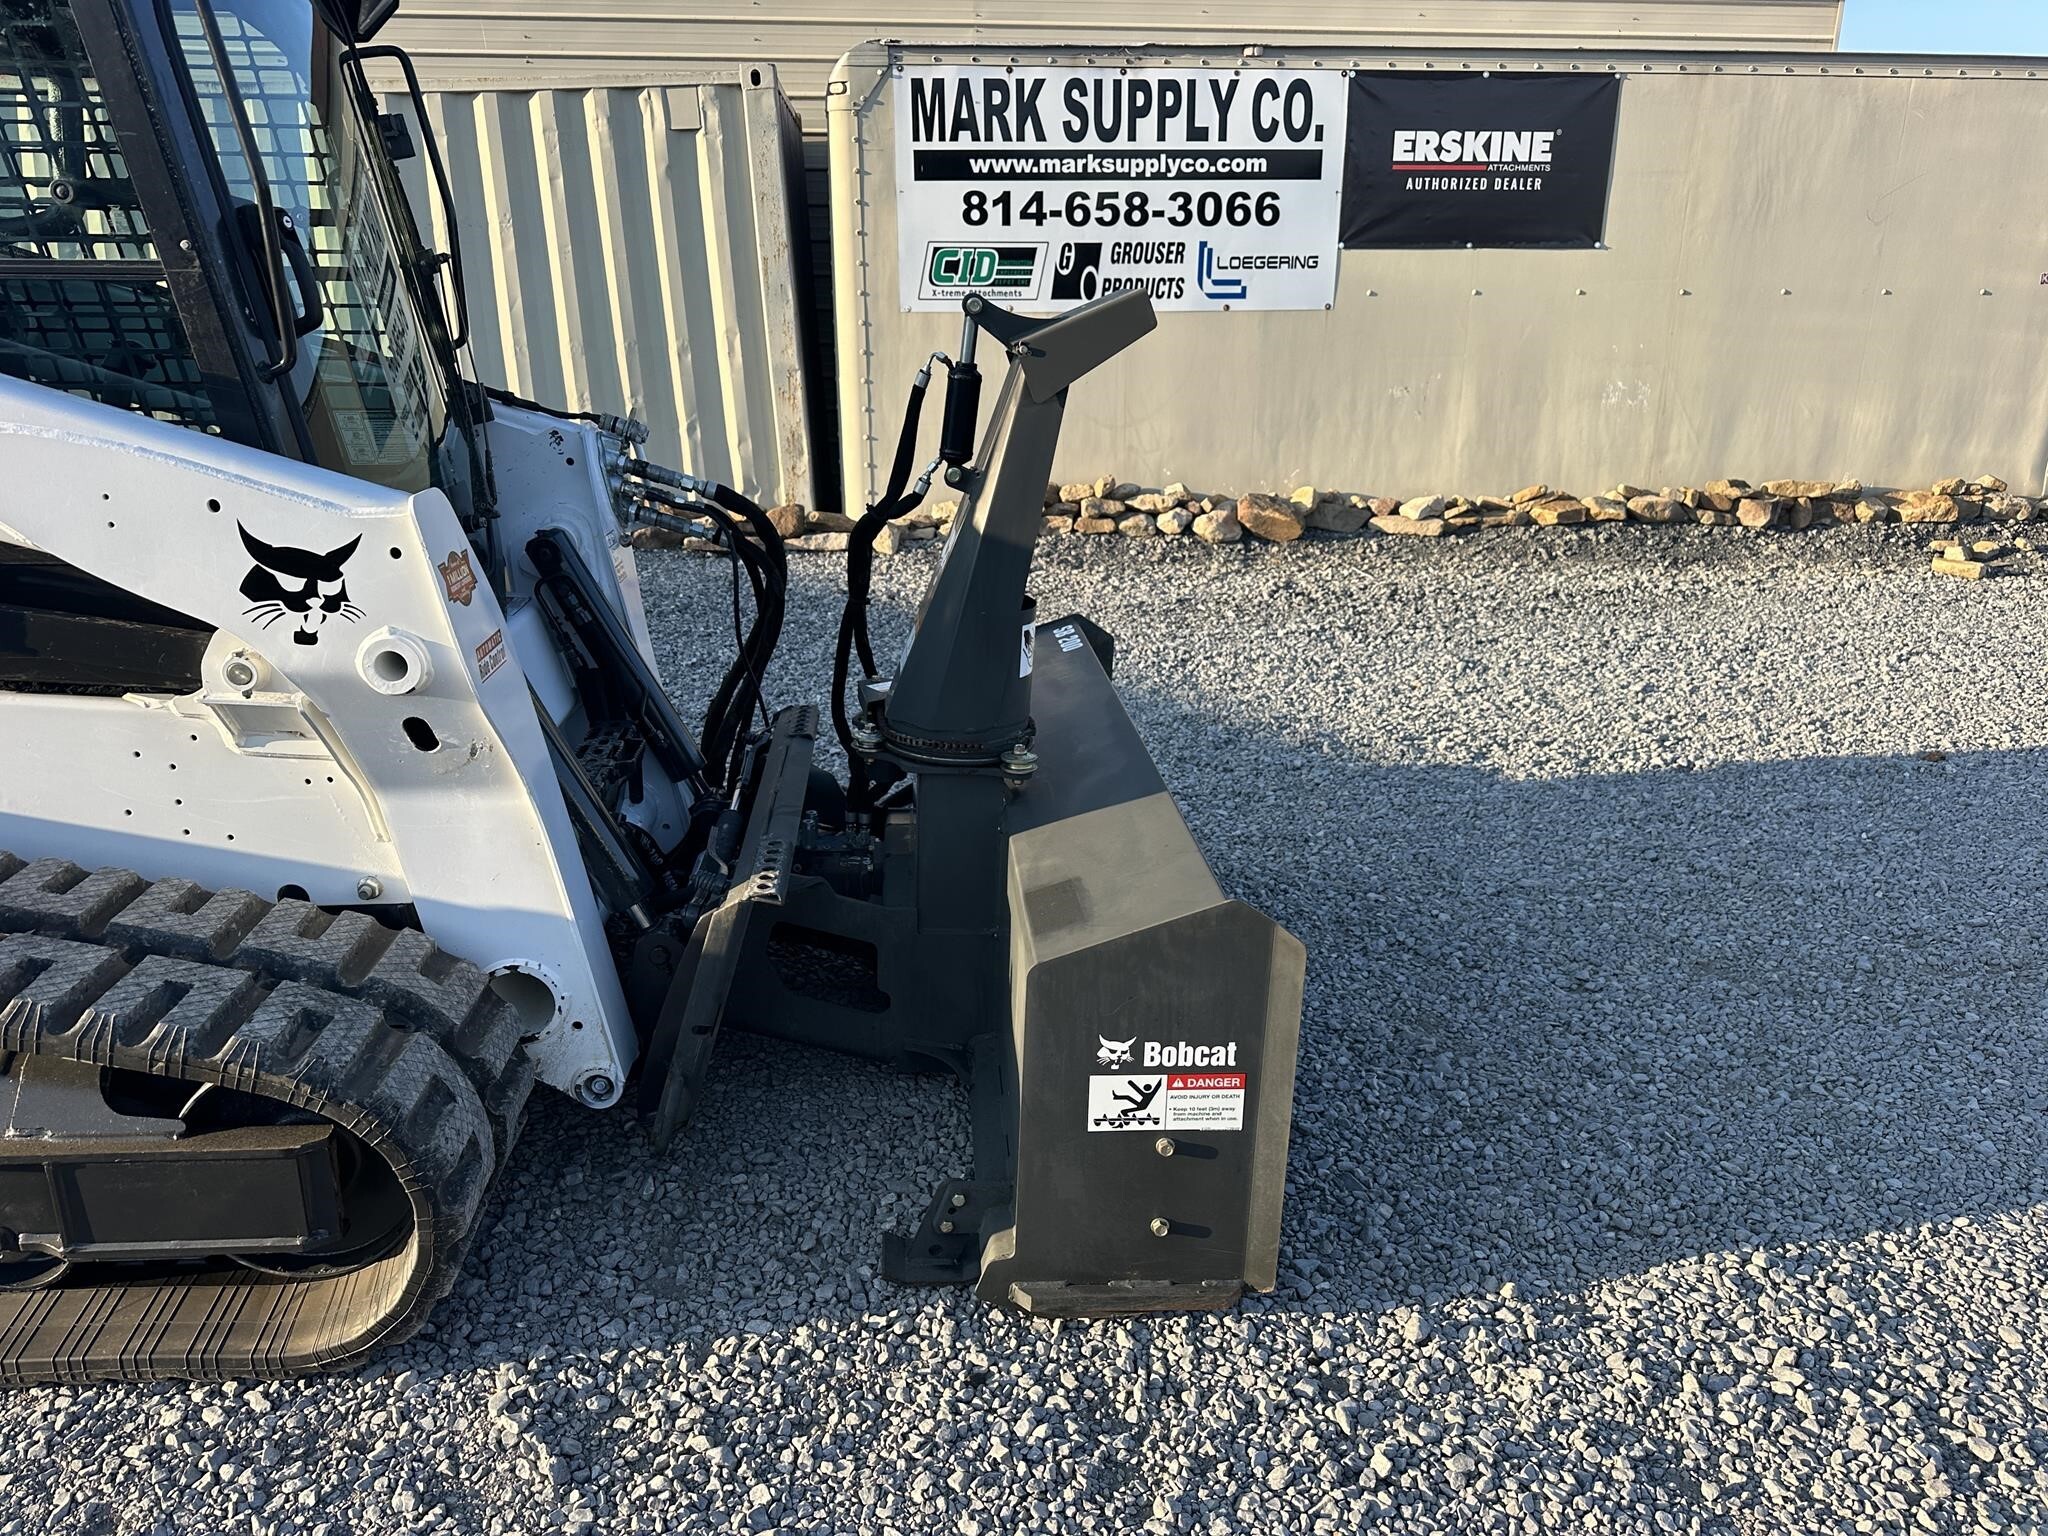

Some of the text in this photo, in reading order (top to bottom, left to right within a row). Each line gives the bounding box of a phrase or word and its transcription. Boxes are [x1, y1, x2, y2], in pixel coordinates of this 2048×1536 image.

[911, 77, 1324, 143] MARK SUPPLY CO.
[1392, 130, 1555, 163] ERSKINE
[969, 153, 1267, 178] www.marksupplyco.com
[1487, 163, 1551, 172] ATTACHMENTS
[1405, 177, 1542, 191] AUTHORIZED DEALER
[962, 190, 1281, 228] 814-658-3066
[1110, 241, 1186, 265] GROUSER
[1217, 255, 1319, 270] LOEGERING
[931, 247, 999, 286] CID
[932, 289, 966, 297] X-treme
[1058, 634, 1083, 652] 200
[1143, 1041, 1237, 1068] Bobcat
[1187, 1077, 1241, 1088] DANGER
